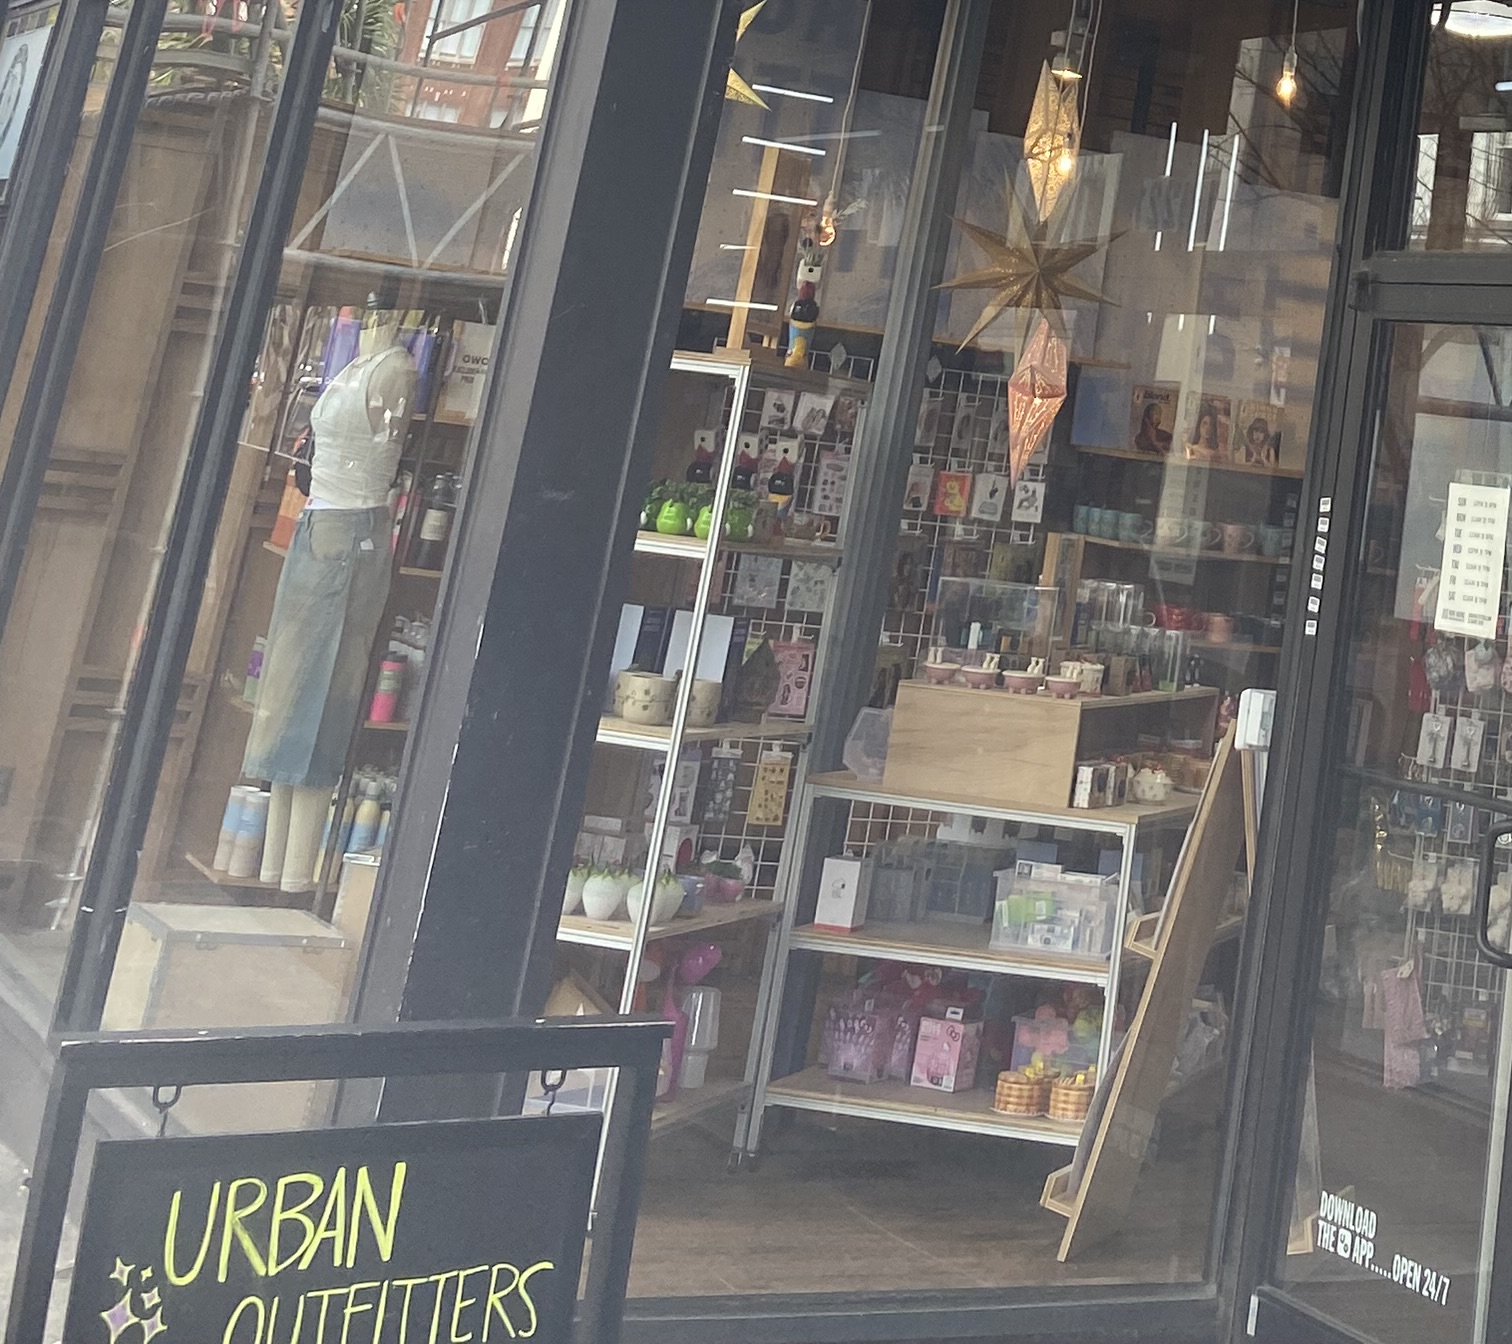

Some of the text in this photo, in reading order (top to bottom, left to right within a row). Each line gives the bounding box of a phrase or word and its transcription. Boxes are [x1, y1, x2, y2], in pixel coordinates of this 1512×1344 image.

[164, 1162, 407, 1286] URBAN
[1319, 1190, 1377, 1239] DOWNLOAD
[1317, 1219, 1337, 1253] THE
[1421, 1268, 1450, 1306] 24/7
